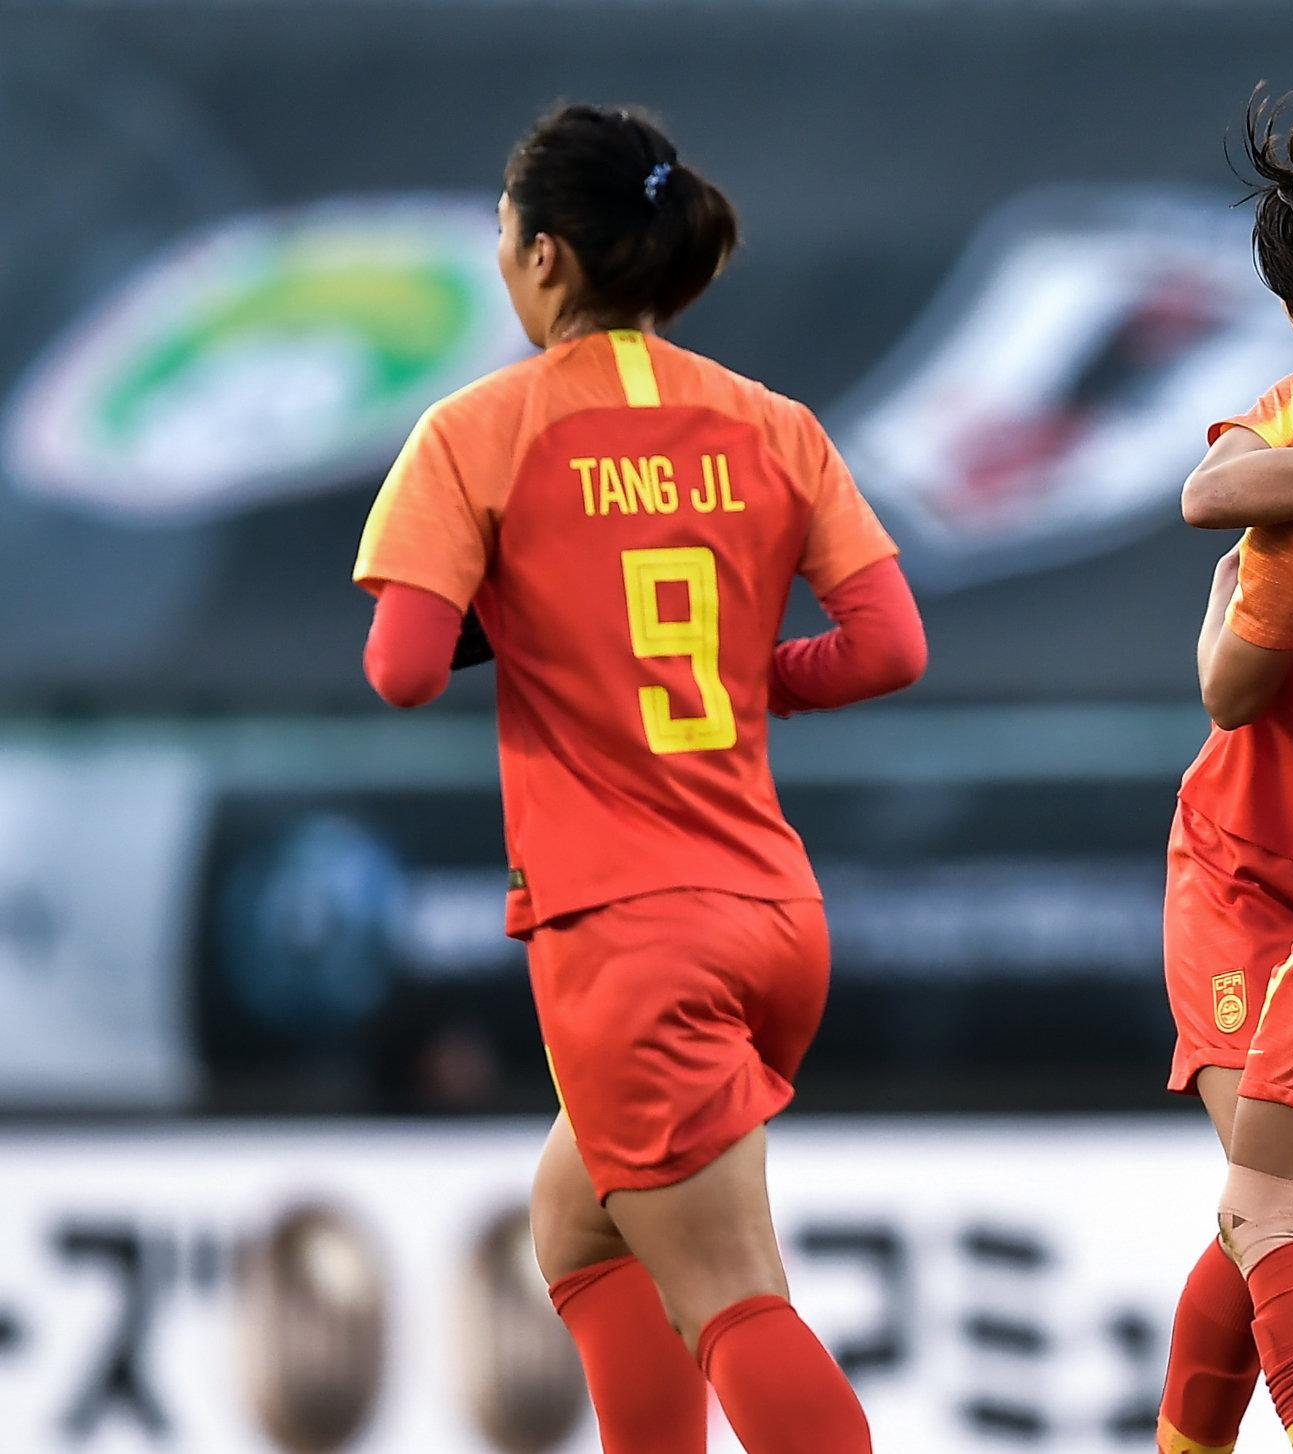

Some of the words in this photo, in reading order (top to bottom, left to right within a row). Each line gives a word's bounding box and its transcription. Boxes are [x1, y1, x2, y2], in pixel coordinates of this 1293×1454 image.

[569, 455, 679, 516] TANG
[690, 453, 746, 513] JL
[620, 546, 737, 754] 9
[1215, 974, 1241, 991] CFA
